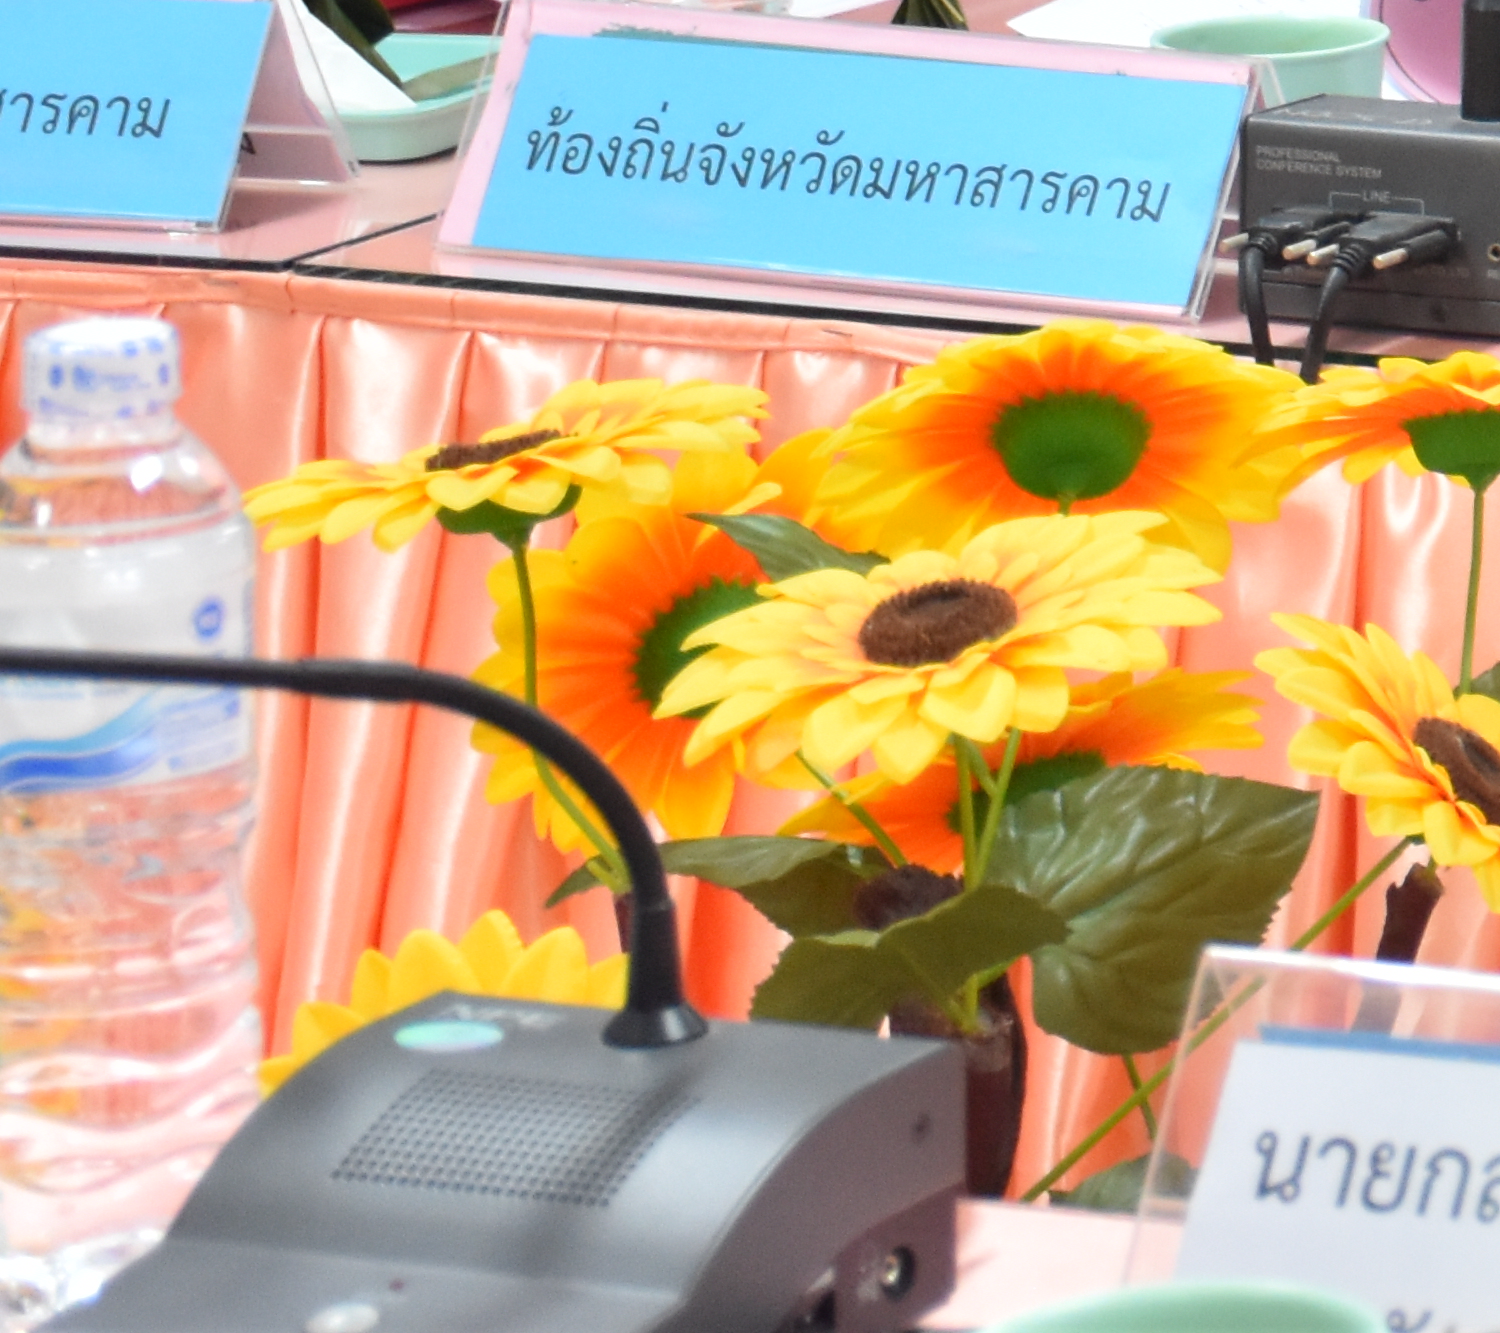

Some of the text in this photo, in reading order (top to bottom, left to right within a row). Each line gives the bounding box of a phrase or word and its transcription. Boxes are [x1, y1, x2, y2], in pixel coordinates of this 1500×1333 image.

[0, 89, 170, 138] ารคาม
[526, 99, 1171, 222] ท้องถิ่นจังหวัดมหาสารคาม
[1256, 159, 1382, 179] CONFERENCE SYSTEM
[1363, 190, 1391, 203] LINE
